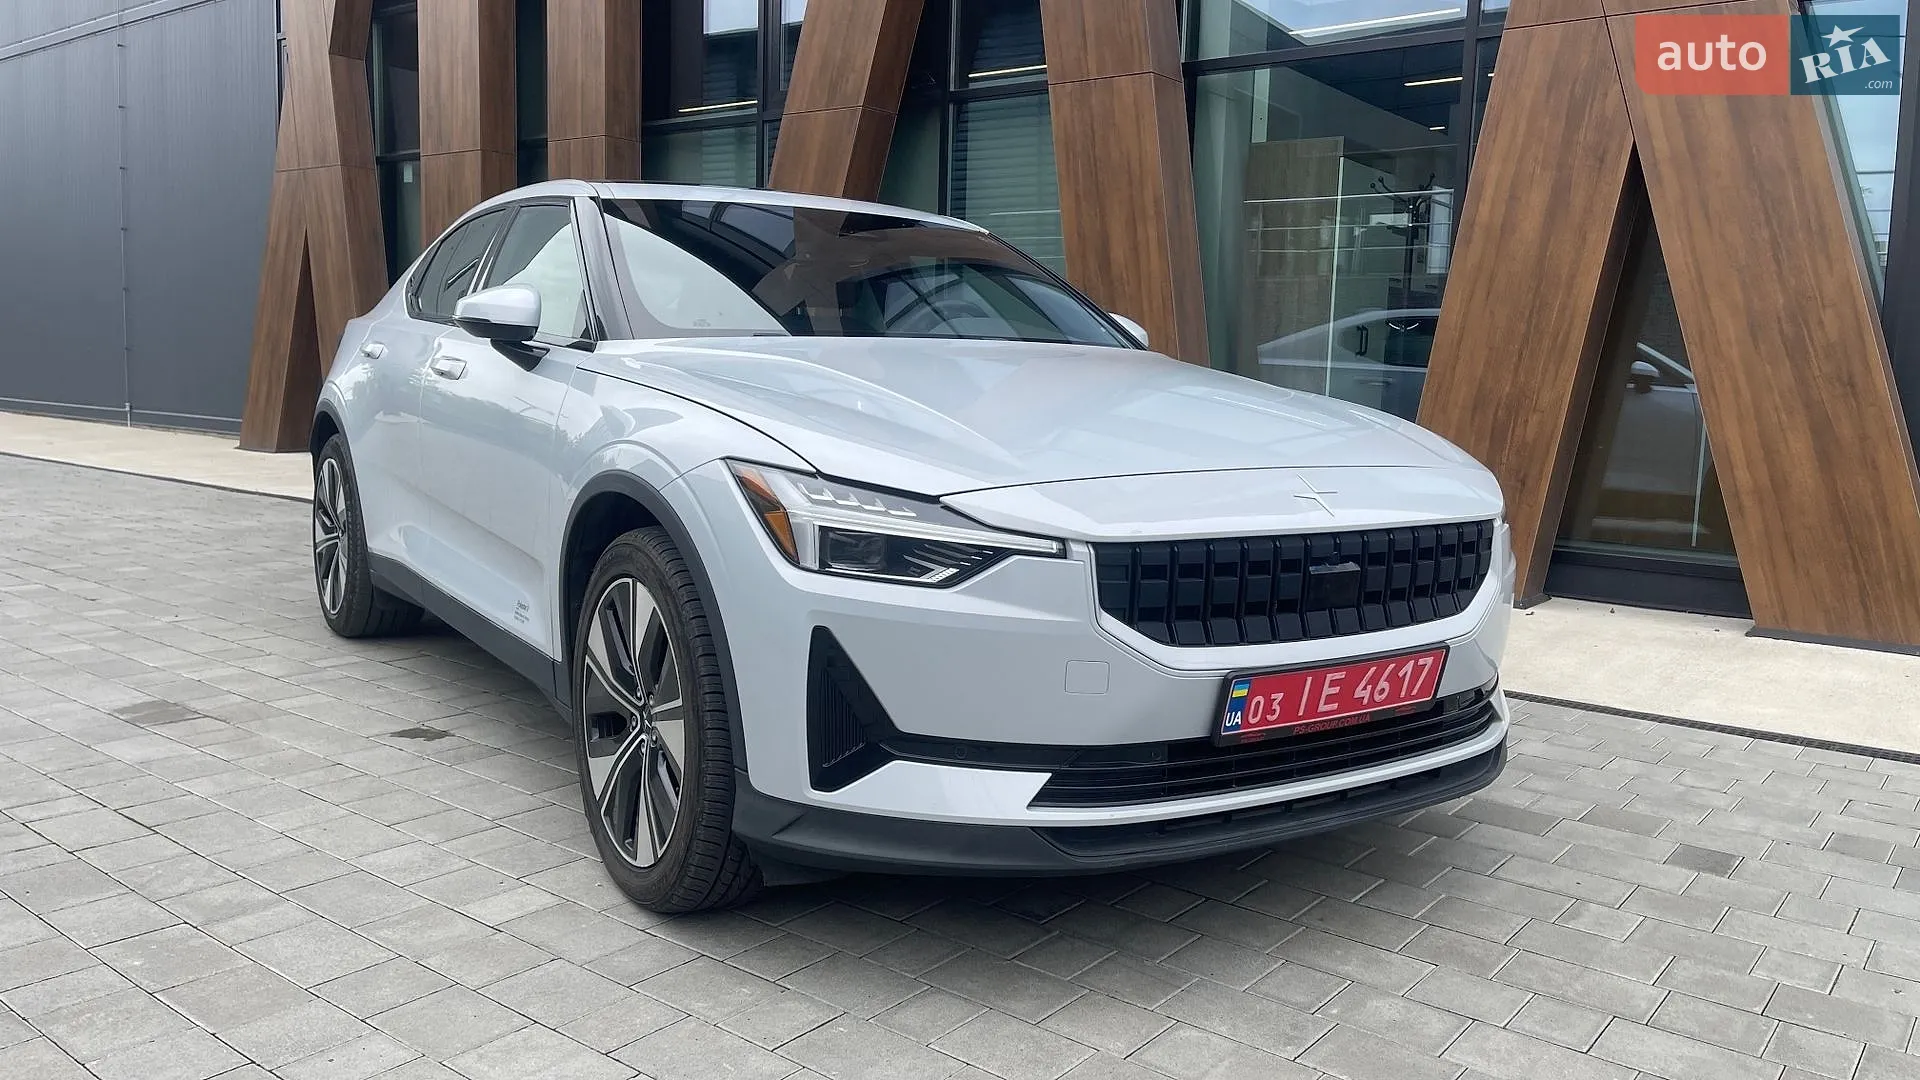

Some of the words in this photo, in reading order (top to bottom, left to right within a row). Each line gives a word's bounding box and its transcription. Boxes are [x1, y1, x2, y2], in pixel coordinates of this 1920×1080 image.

[1247, 692, 1285, 725] 03
[1297, 671, 1347, 717] IE
[1353, 656, 1434, 706] 4617
[1225, 710, 1242, 727] UA
